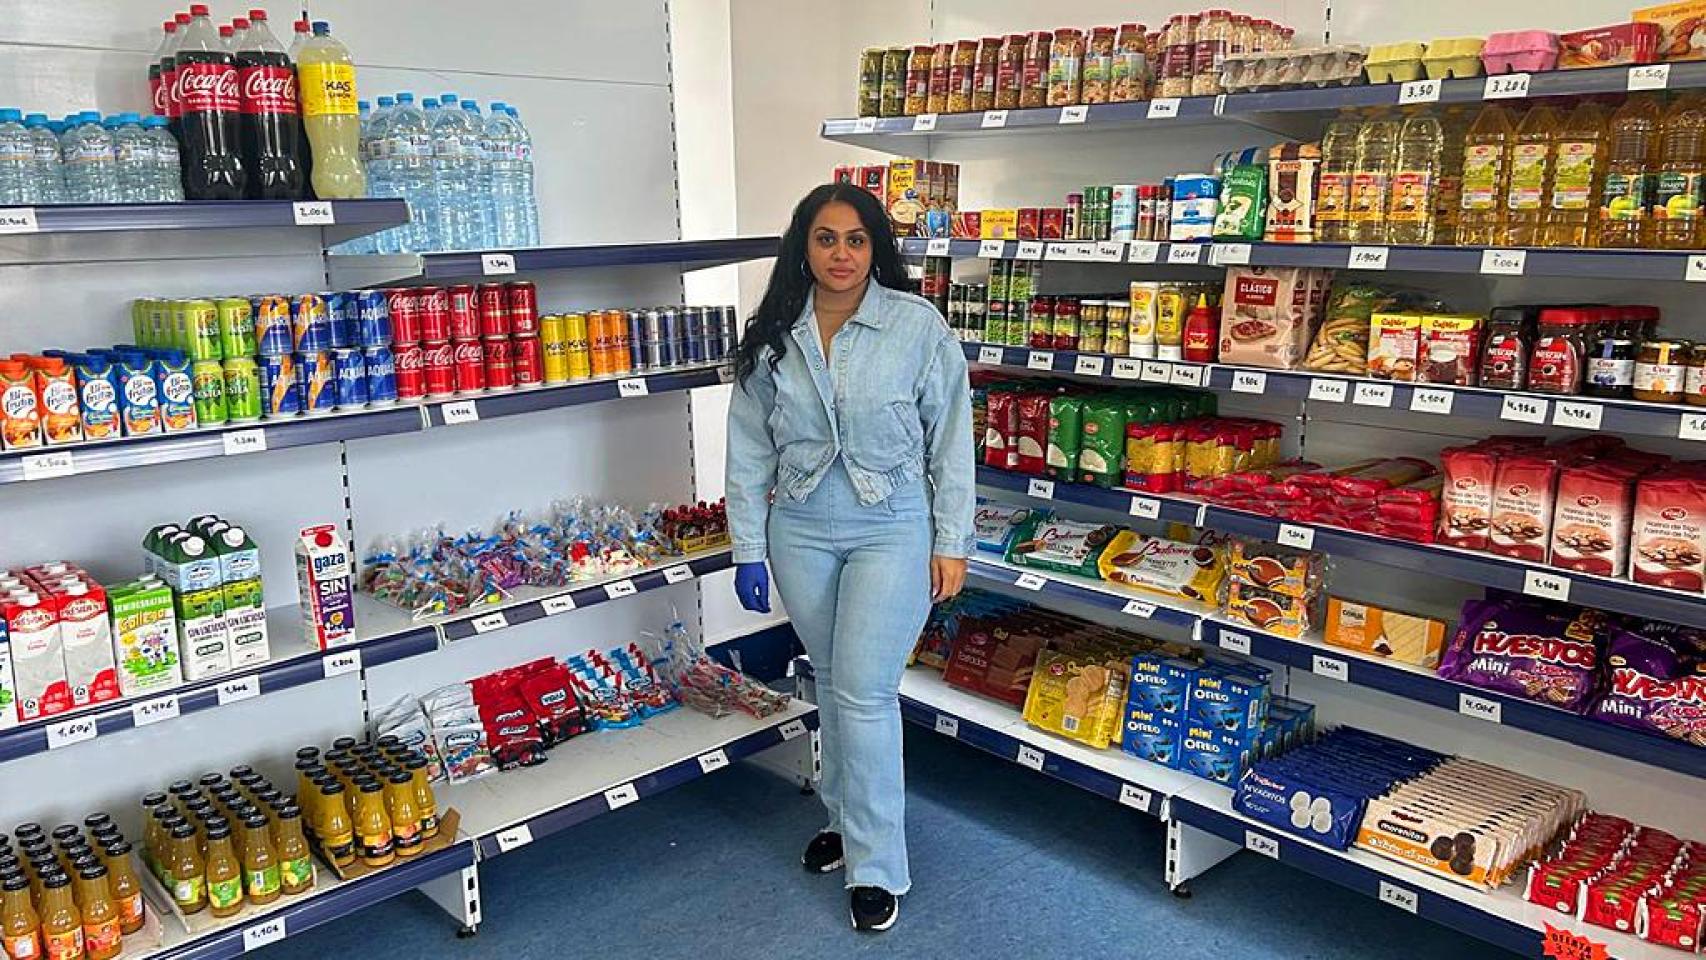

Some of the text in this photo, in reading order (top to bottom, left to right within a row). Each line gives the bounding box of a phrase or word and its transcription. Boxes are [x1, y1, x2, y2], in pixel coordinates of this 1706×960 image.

[326, 81, 351, 91] KAS
[1407, 85, 1433, 97] 3.50
[314, 552, 346, 573] gaza
[319, 578, 346, 596] SIN
[1473, 630, 1597, 670] HUESITOS
[1470, 657, 1510, 676] Mini
[1602, 697, 1643, 720] Mini
